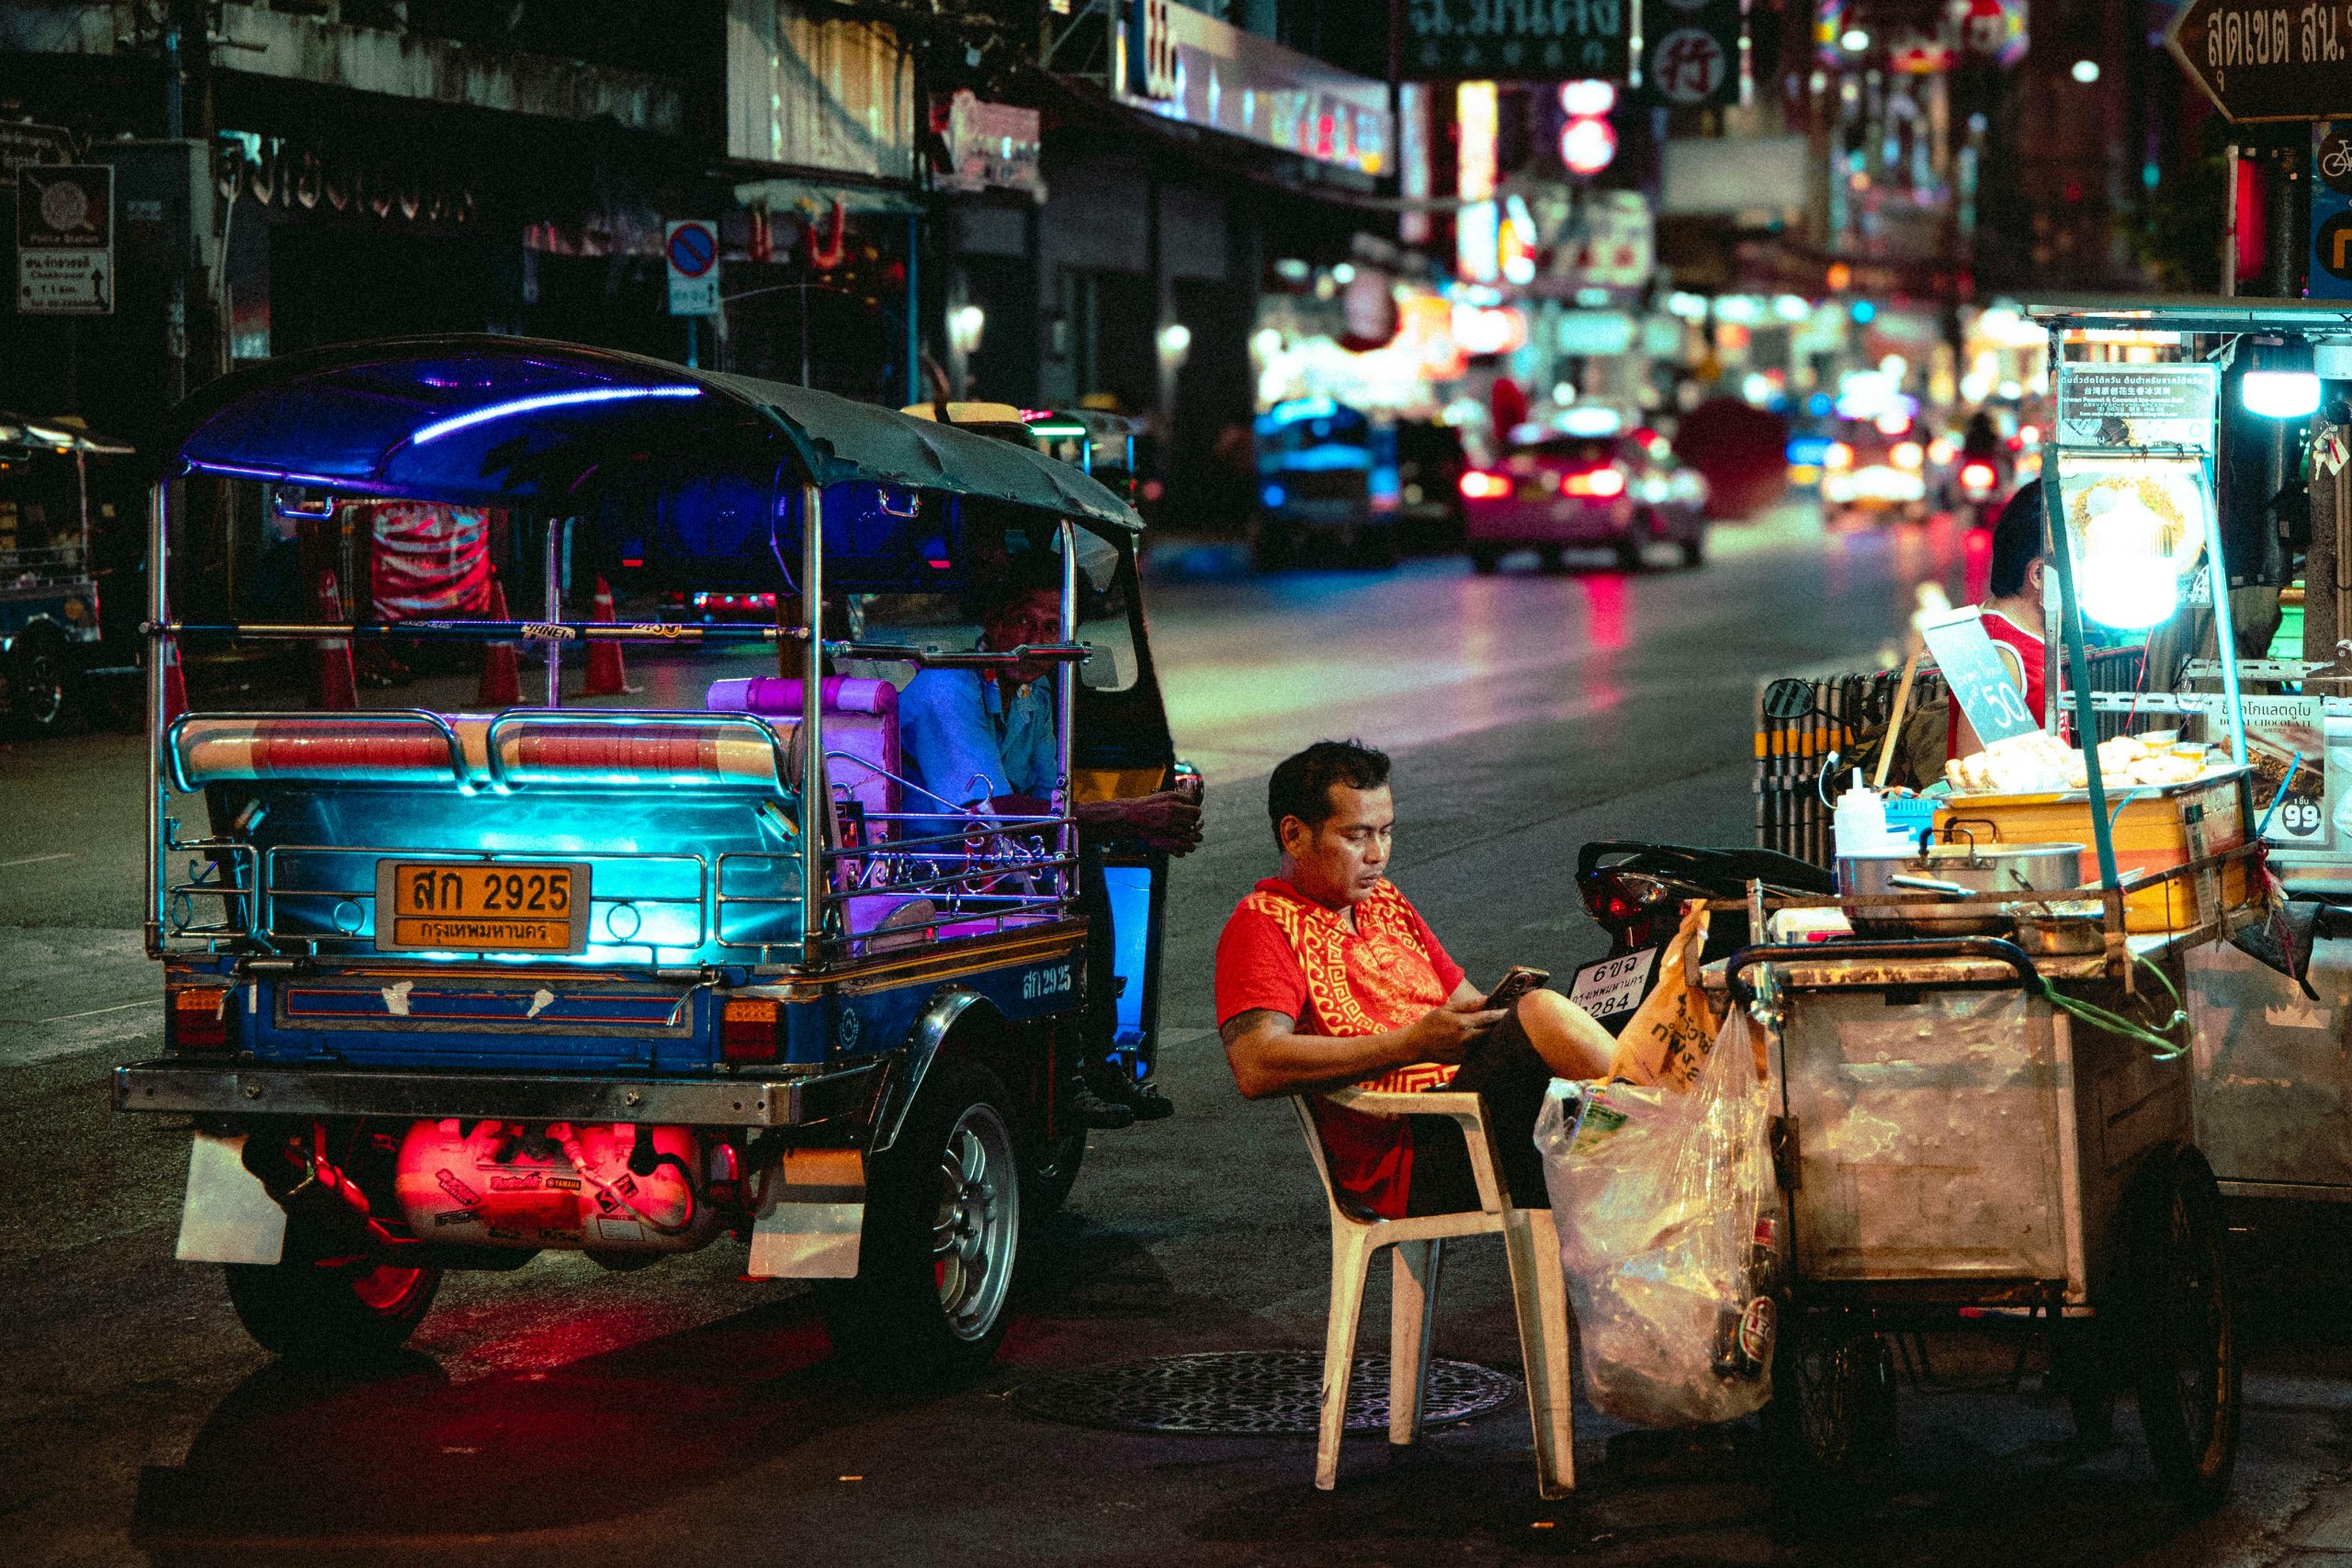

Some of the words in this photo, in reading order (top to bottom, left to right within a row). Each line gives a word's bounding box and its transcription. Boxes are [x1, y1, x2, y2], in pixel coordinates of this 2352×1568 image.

[2207, 7, 2290, 92] สุดเขต
[2301, 3, 2352, 63] สน.
[2254, 718, 2312, 728] CHOCOLATE
[2285, 804, 2318, 828] 99
[413, 870, 463, 910] สก
[483, 874, 570, 911] 2925
[421, 921, 548, 943] กรุงเทพมหานคร
[1572, 974, 1645, 1004] กรุงเทพมหานคร
[554, 1179, 580, 1189] YAMAHA
